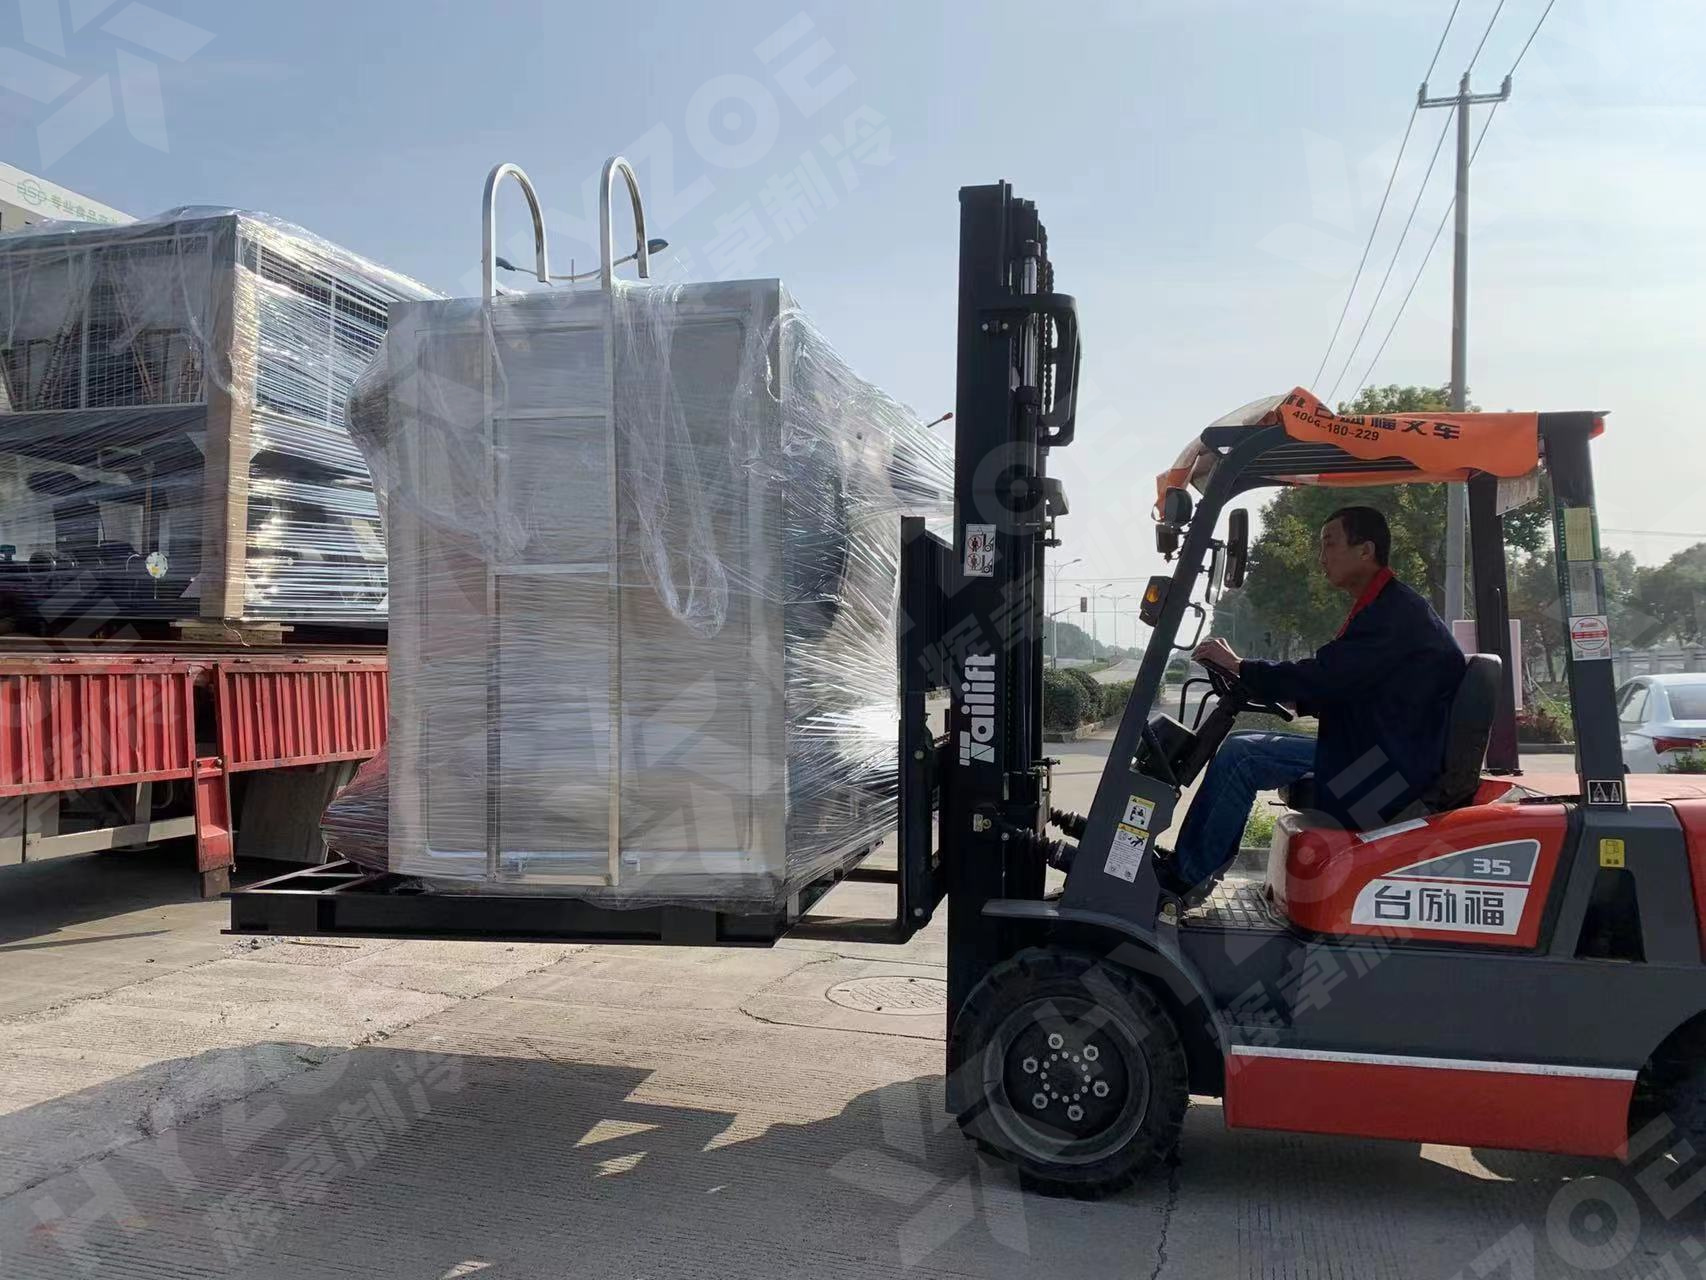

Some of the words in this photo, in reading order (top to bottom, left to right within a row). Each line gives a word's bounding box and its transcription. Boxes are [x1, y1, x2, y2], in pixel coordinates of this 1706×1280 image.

[959, 653, 996, 767] Tailift
[1473, 857, 1512, 876] 35
[1374, 885, 1505, 927] 台励福
